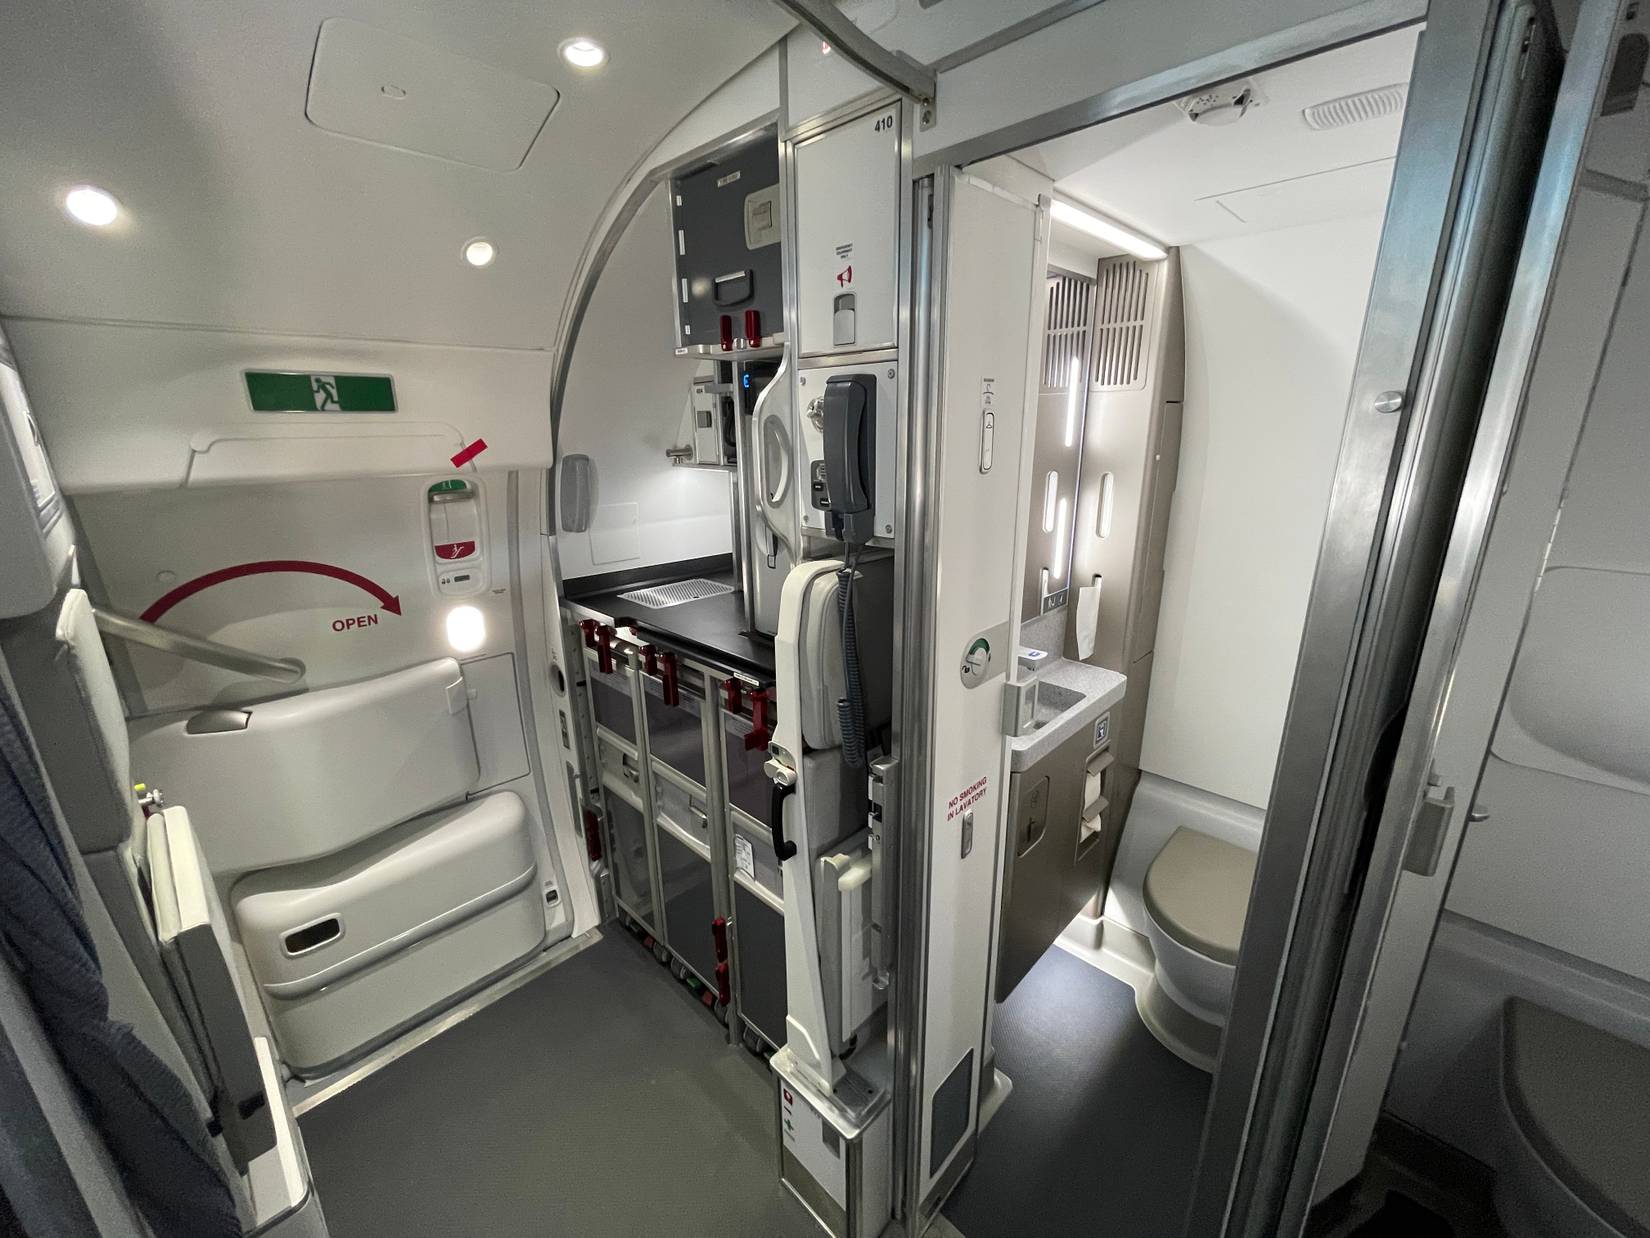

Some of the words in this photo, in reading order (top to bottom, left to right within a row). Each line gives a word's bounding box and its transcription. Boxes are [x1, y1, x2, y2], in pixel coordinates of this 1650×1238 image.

[874, 115, 893, 132] 410
[332, 614, 378, 631] OPEN
[947, 810, 955, 822] IN
[955, 787, 987, 816] LAVATORY
[948, 796, 958, 809] NO
[959, 776, 987, 801] SMOKING
